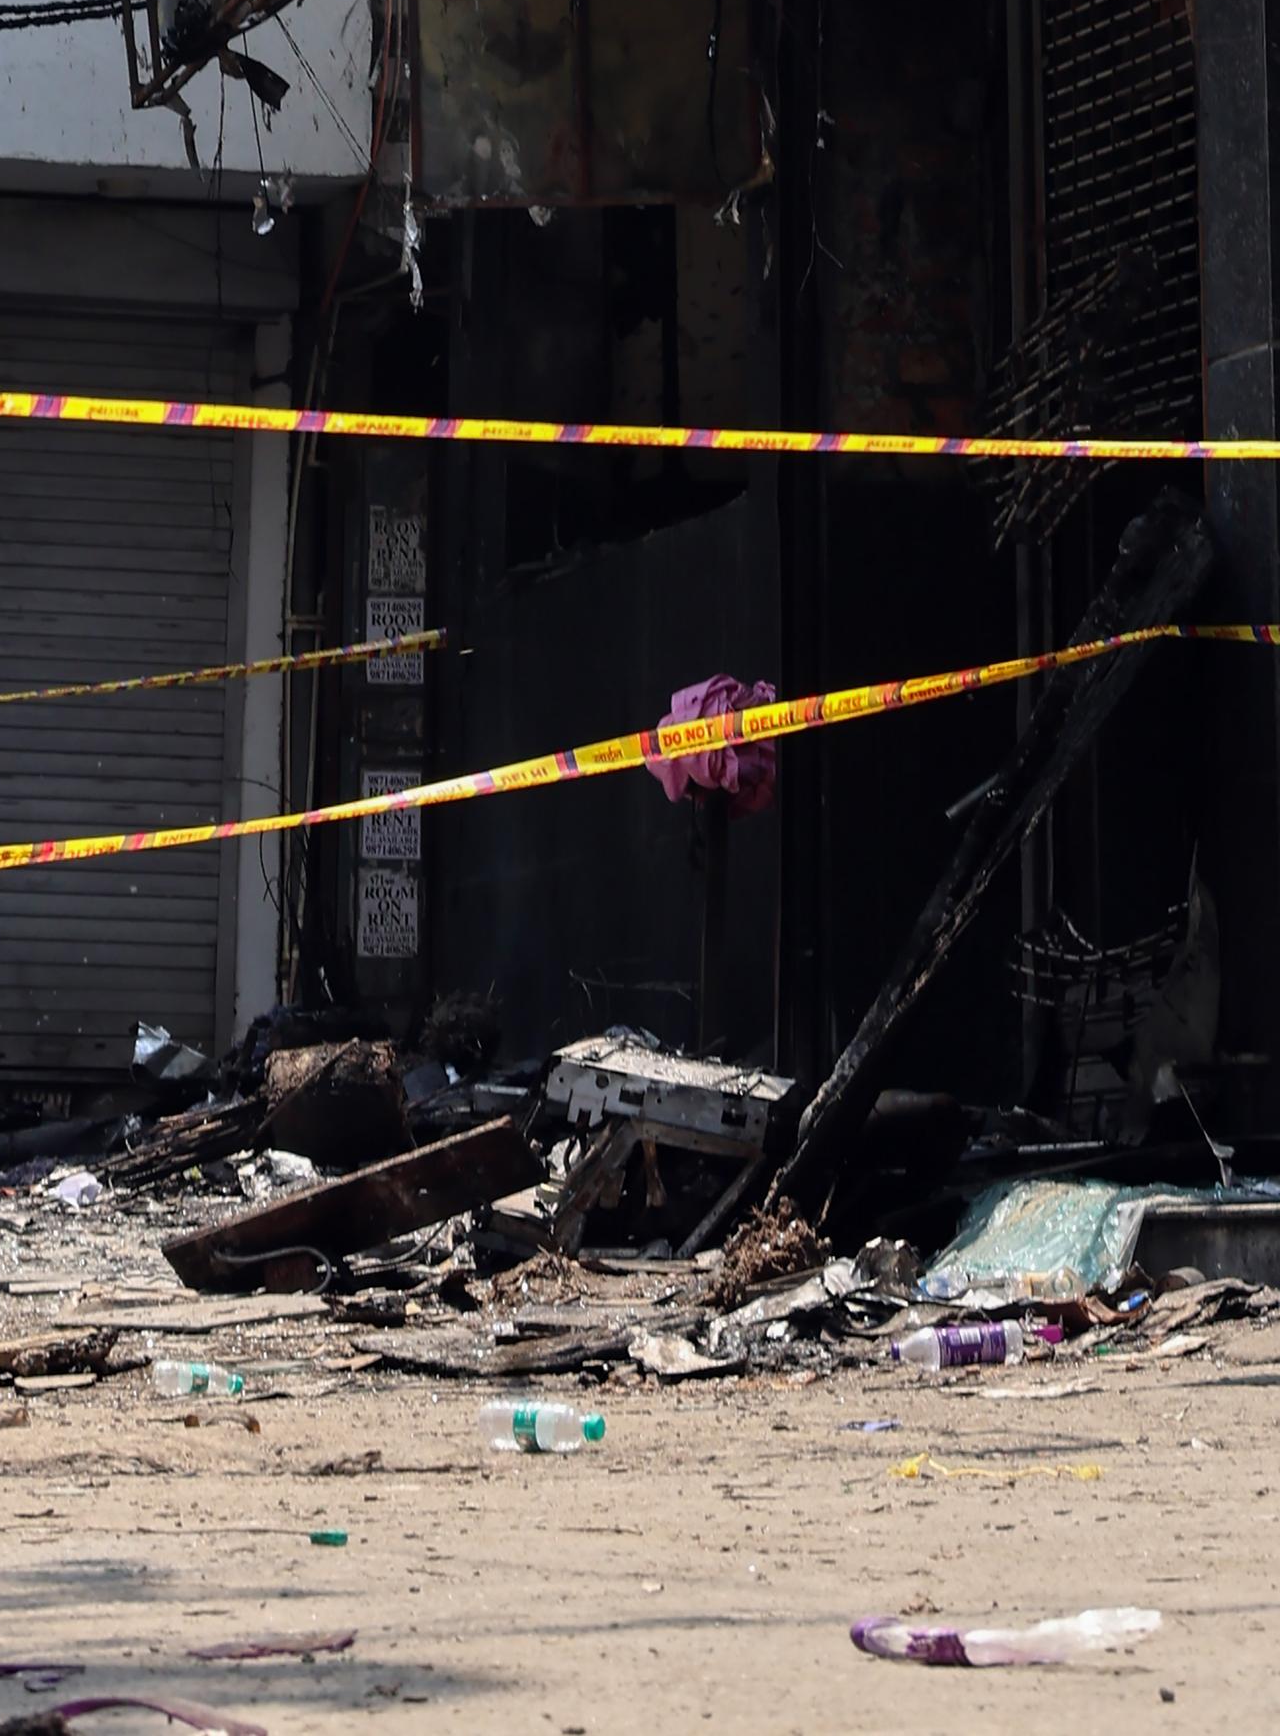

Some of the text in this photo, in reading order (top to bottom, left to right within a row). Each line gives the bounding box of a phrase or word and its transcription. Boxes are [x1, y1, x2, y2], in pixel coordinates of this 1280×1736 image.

[371, 614, 421, 626] ROOM
[749, 710, 796, 733] DELHI
[662, 723, 714, 748] DO NOT
[371, 814, 416, 827] RENT
[378, 900, 401, 912] ON
[368, 913, 413, 926] RENT
